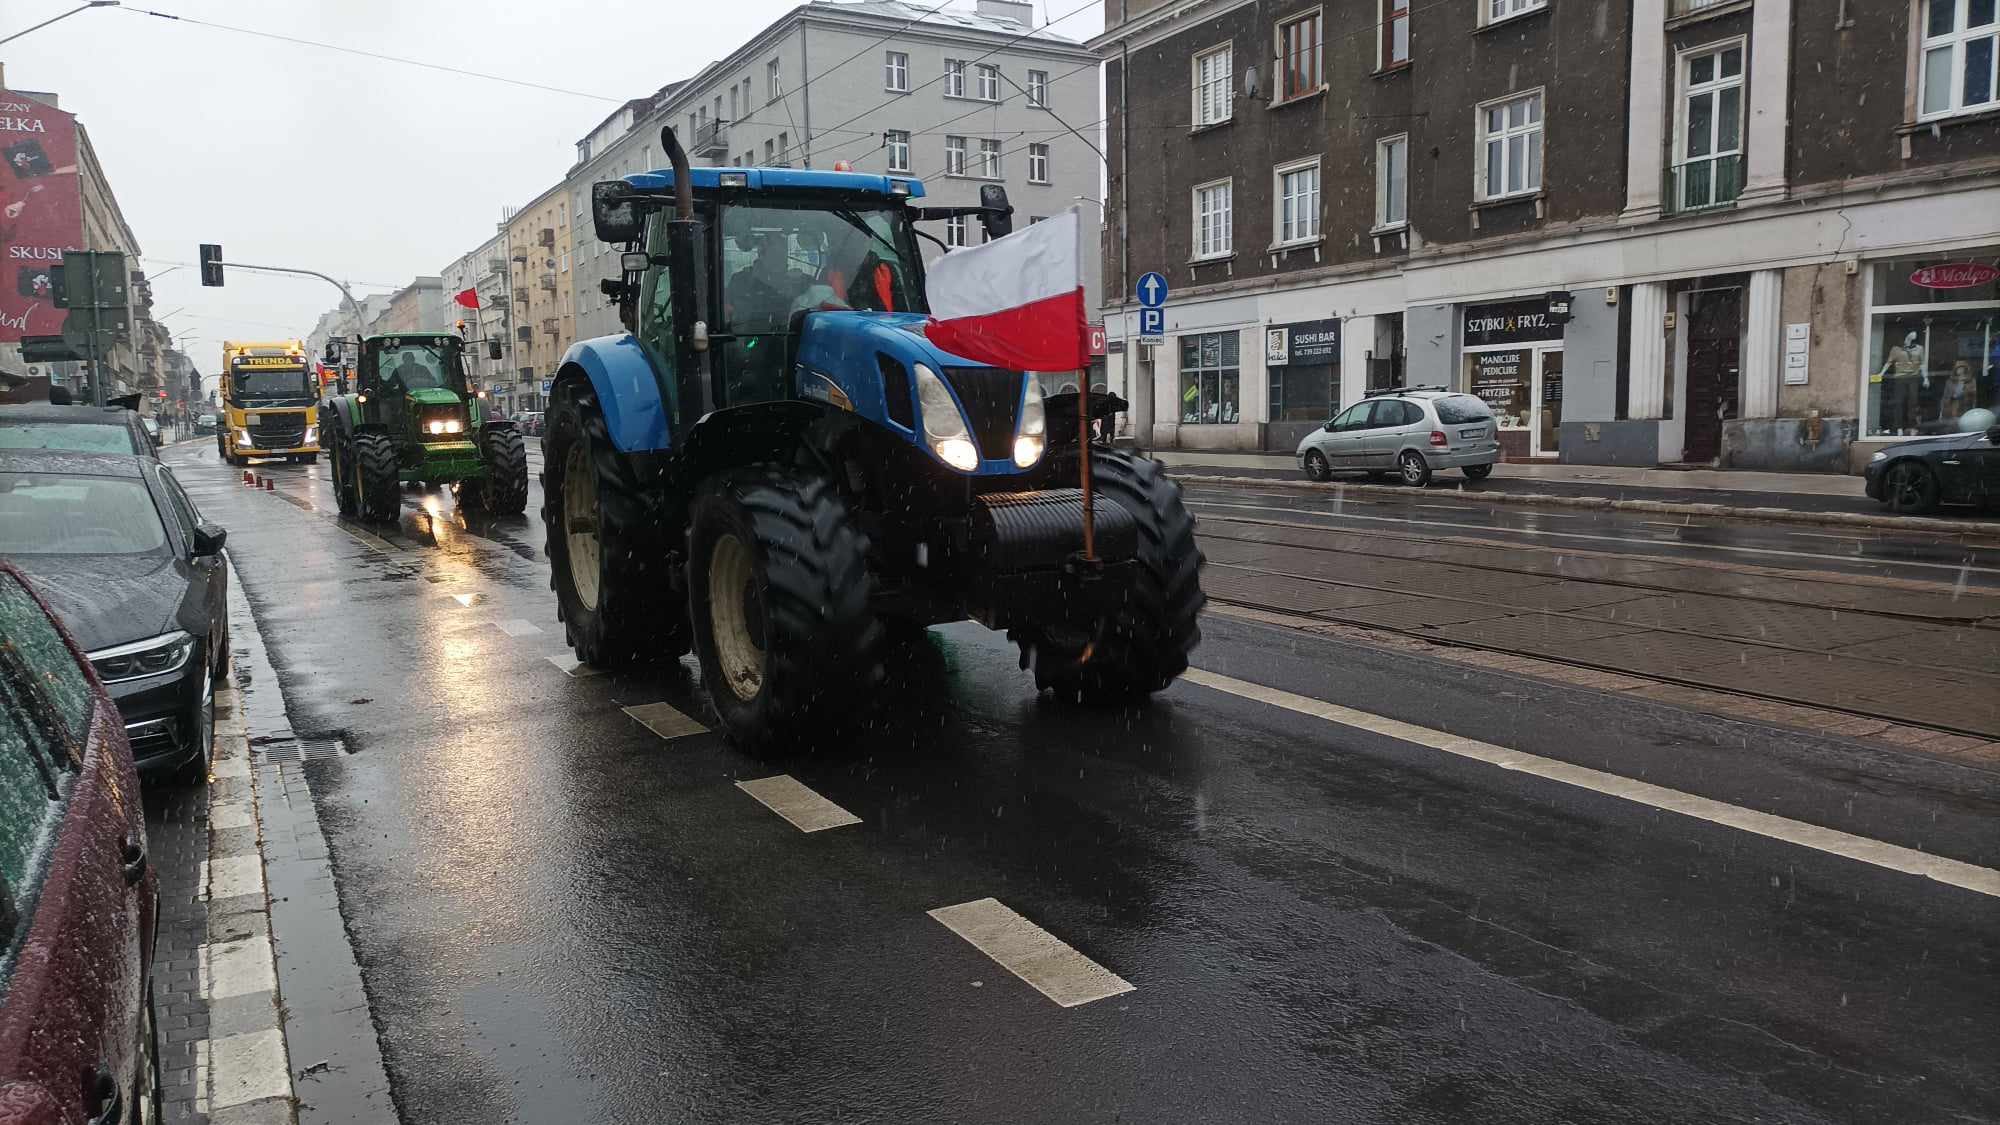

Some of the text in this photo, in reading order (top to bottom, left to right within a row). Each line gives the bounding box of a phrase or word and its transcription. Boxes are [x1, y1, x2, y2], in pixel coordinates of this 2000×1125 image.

[0, 102, 31, 113] ZNY
[9, 245, 80, 260] SKUSI
[1468, 317, 1505, 332] SZYBKI
[1294, 331, 1335, 345] SUSHI BAR
[247, 357, 292, 365] TRENDA
[1481, 354, 1521, 365] MANICURE
[1483, 365, 1518, 376] PEDICURE
[1482, 388, 1511, 398] FRYZJER
